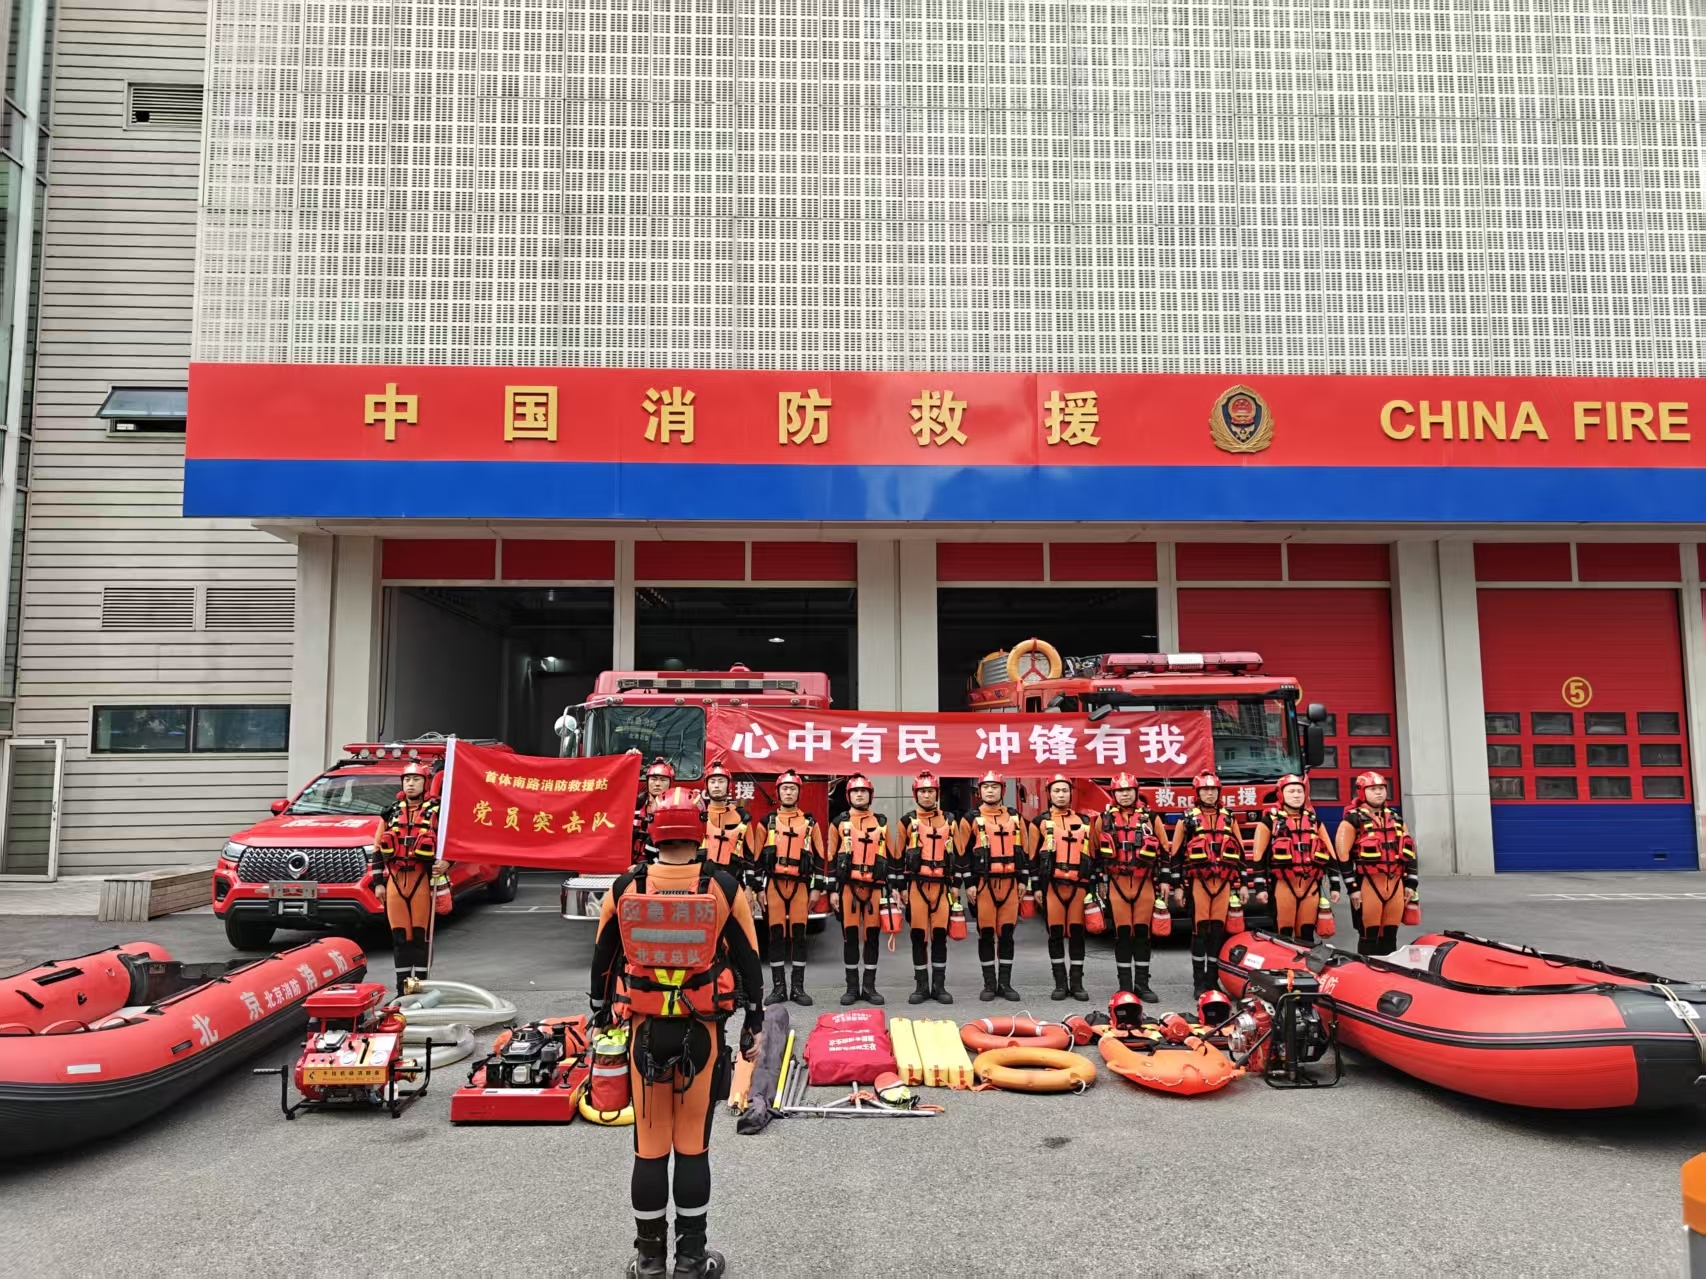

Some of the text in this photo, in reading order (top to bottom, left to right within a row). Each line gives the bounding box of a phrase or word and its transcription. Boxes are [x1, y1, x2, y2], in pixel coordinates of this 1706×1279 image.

[364, 382, 1101, 447] 中国消防救援
[1380, 399, 1692, 442] CHINA FIRE
[1569, 681, 1586, 704] 5
[730, 721, 1188, 765] 心中有民 冲锋有我
[484, 770, 609, 793] 首体南路消防救援站
[735, 781, 755, 800] 援
[1155, 787, 1175, 807] 救
[1238, 787, 1257, 806] 援
[472, 800, 616, 834] 党员突击队
